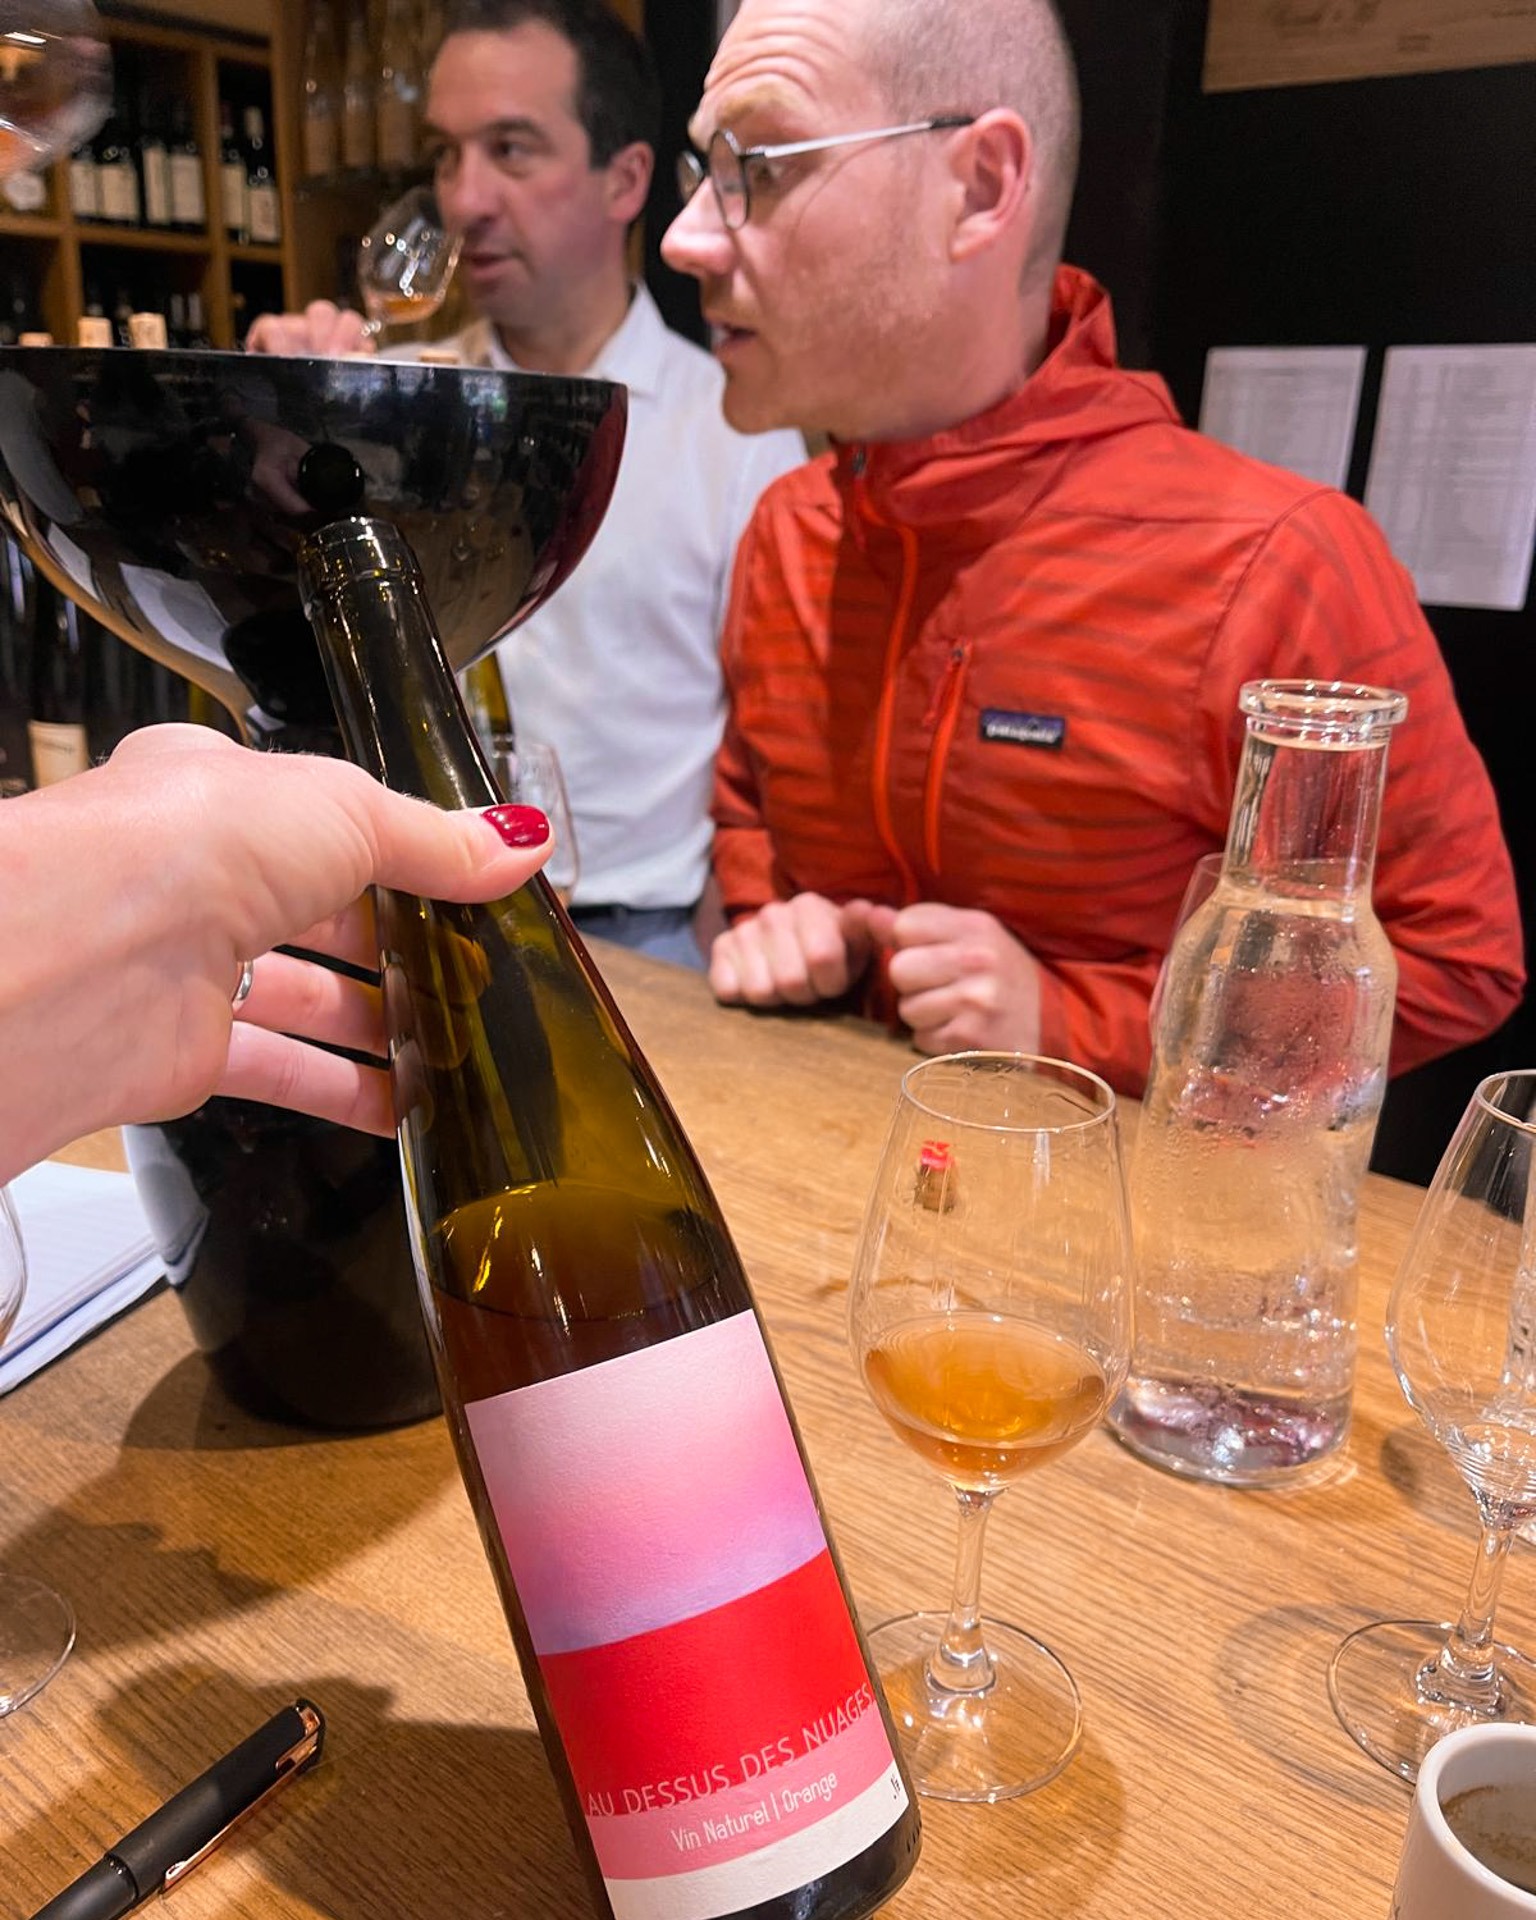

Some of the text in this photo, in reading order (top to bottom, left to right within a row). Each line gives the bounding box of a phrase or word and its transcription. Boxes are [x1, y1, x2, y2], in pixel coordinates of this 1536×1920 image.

[587, 1682, 872, 1816] AU DESSUS DES NUAGES
[670, 1828, 701, 1852] Vin
[702, 1813, 770, 1844] Naturel
[781, 1772, 838, 1813] Orange
